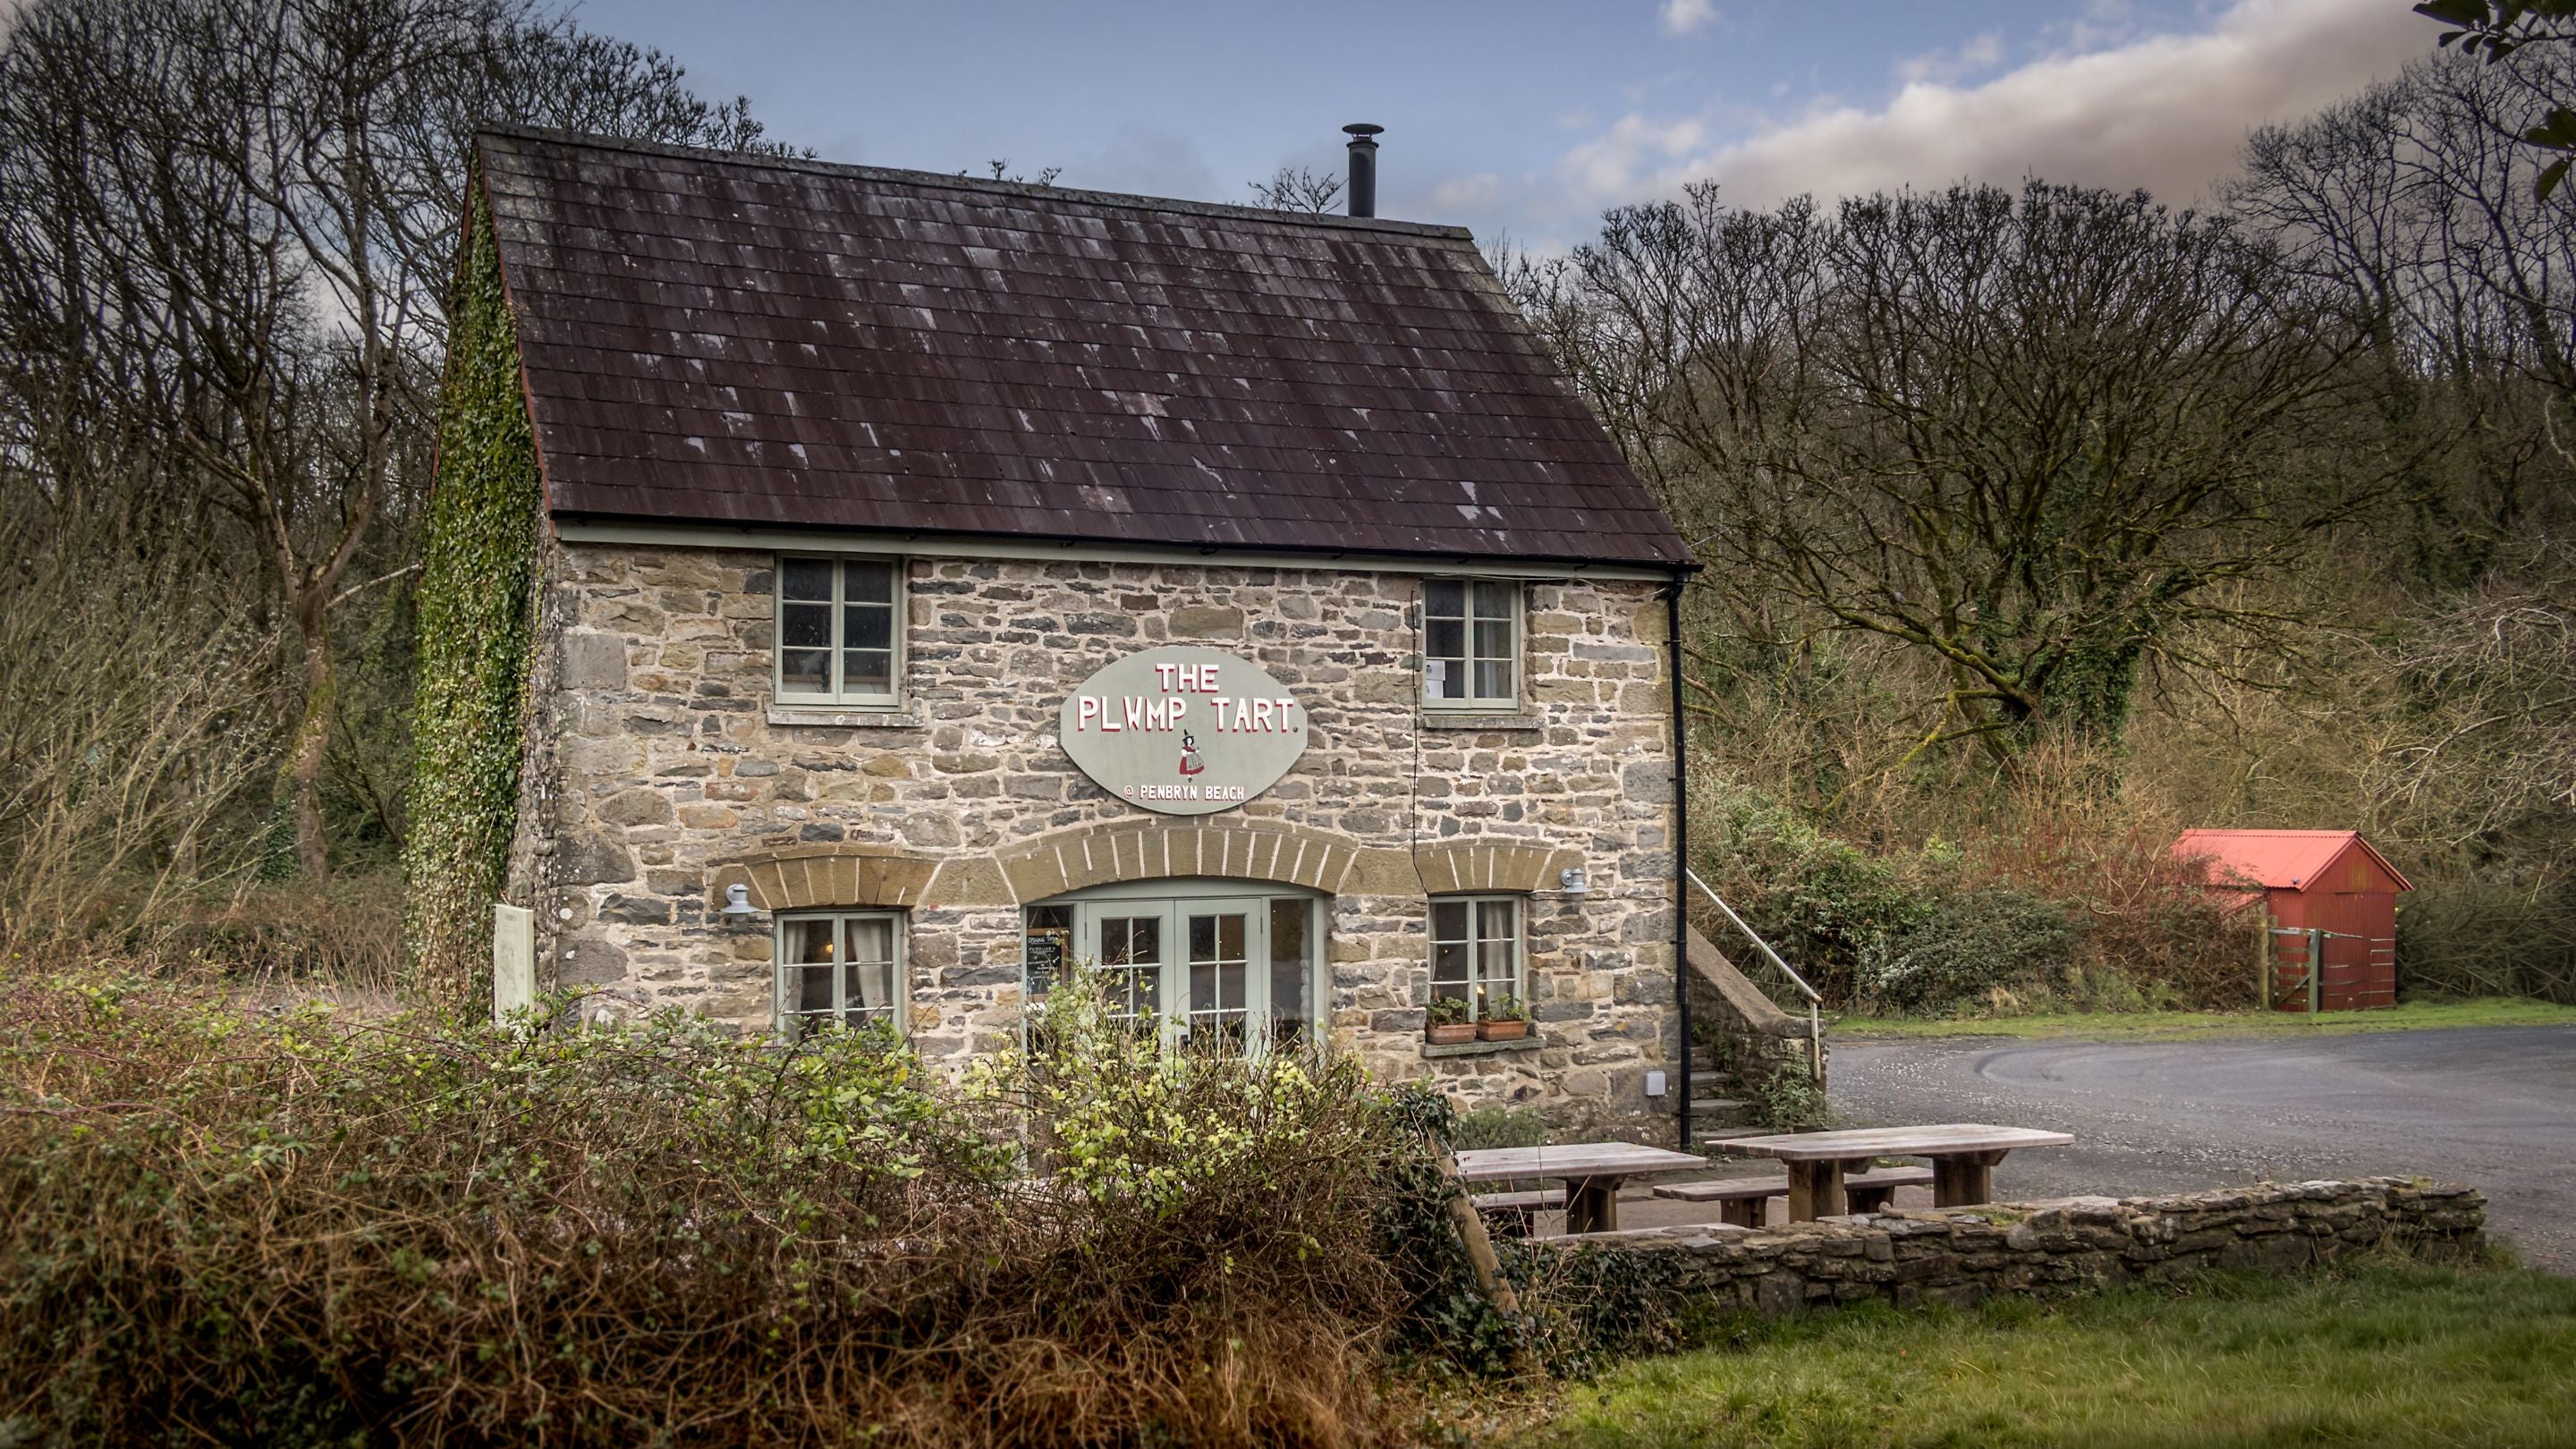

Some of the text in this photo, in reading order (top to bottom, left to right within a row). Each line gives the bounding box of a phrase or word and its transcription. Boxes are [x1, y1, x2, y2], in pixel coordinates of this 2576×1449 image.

[1156, 664, 1219, 692] THE
[1078, 696, 1294, 733] PLWMP TART
[1123, 785, 1244, 801] @ PENBRYN BEACH
